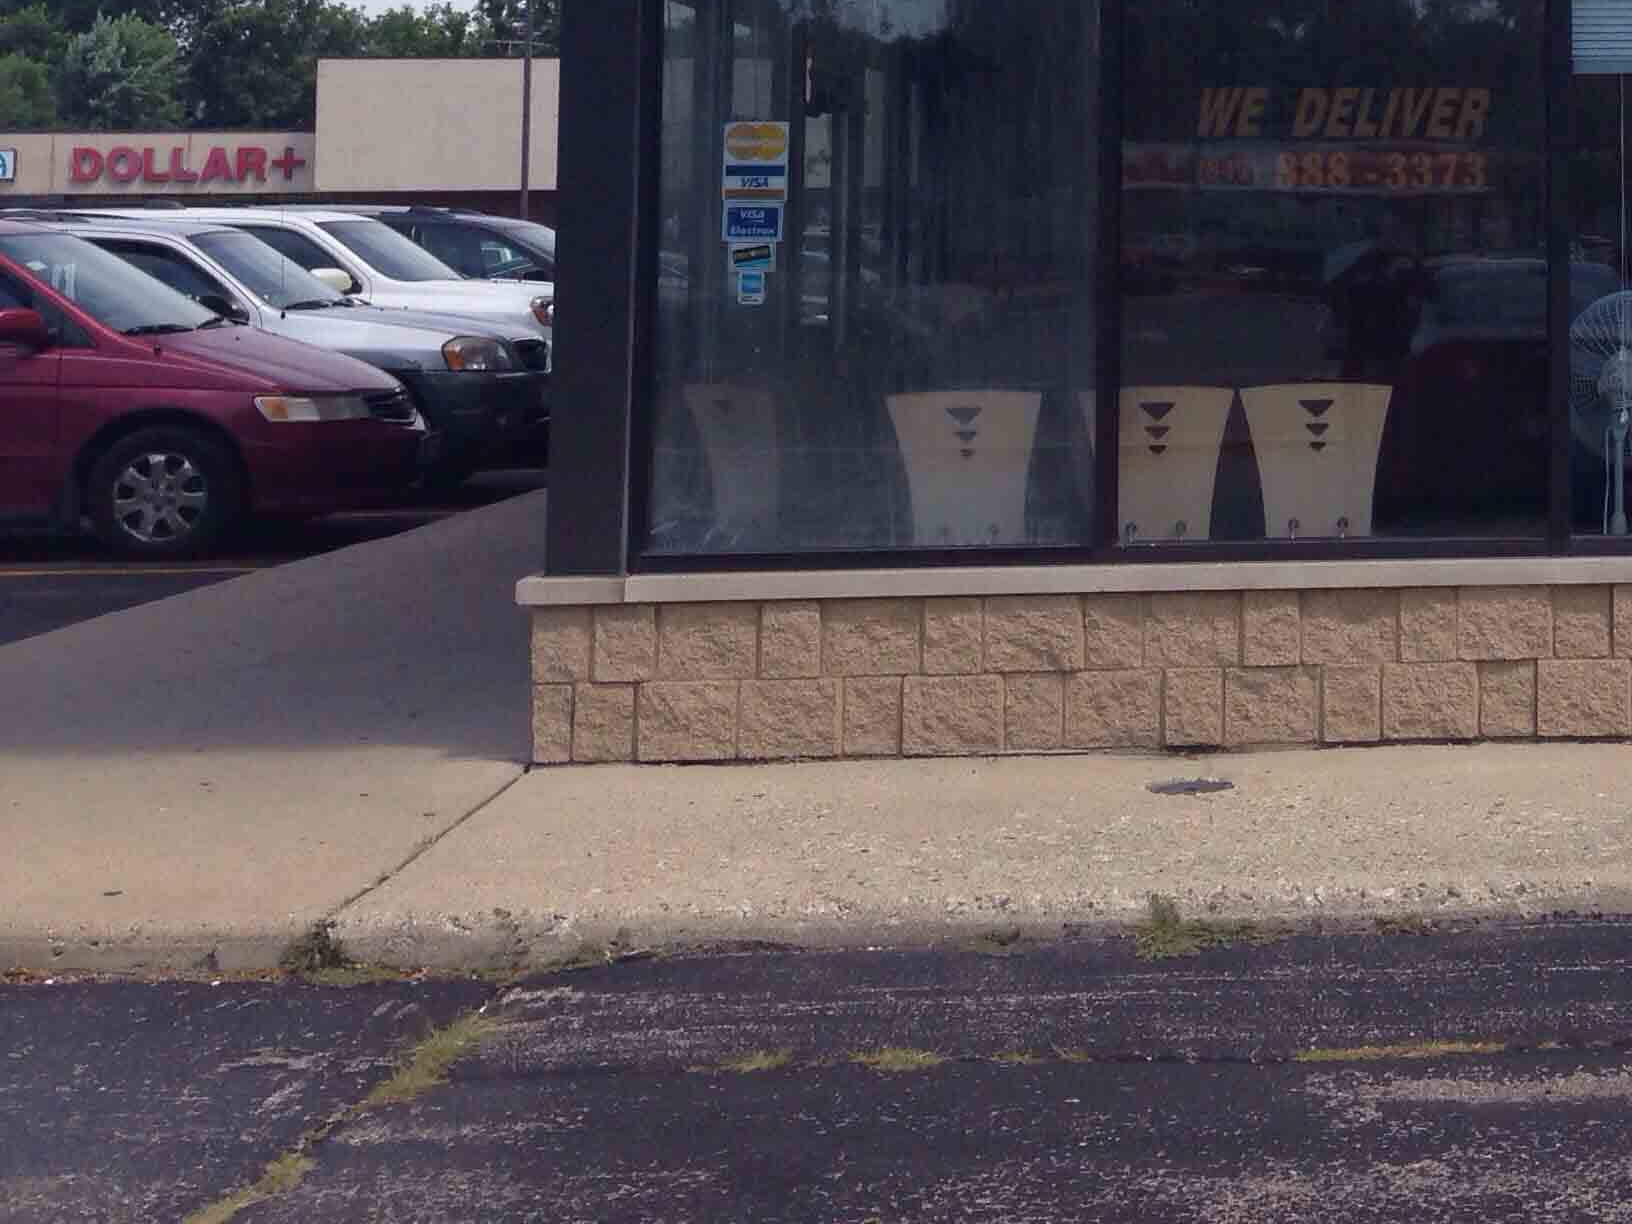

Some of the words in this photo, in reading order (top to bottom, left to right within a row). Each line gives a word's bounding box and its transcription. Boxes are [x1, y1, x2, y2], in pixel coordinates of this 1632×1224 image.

[1197, 87, 1269, 137] WE
[1292, 87, 1491, 137] DELIVER
[69, 146, 307, 184] DOLLAR+
[740, 176, 769, 188] VISA
[739, 208, 765, 219] VISA
